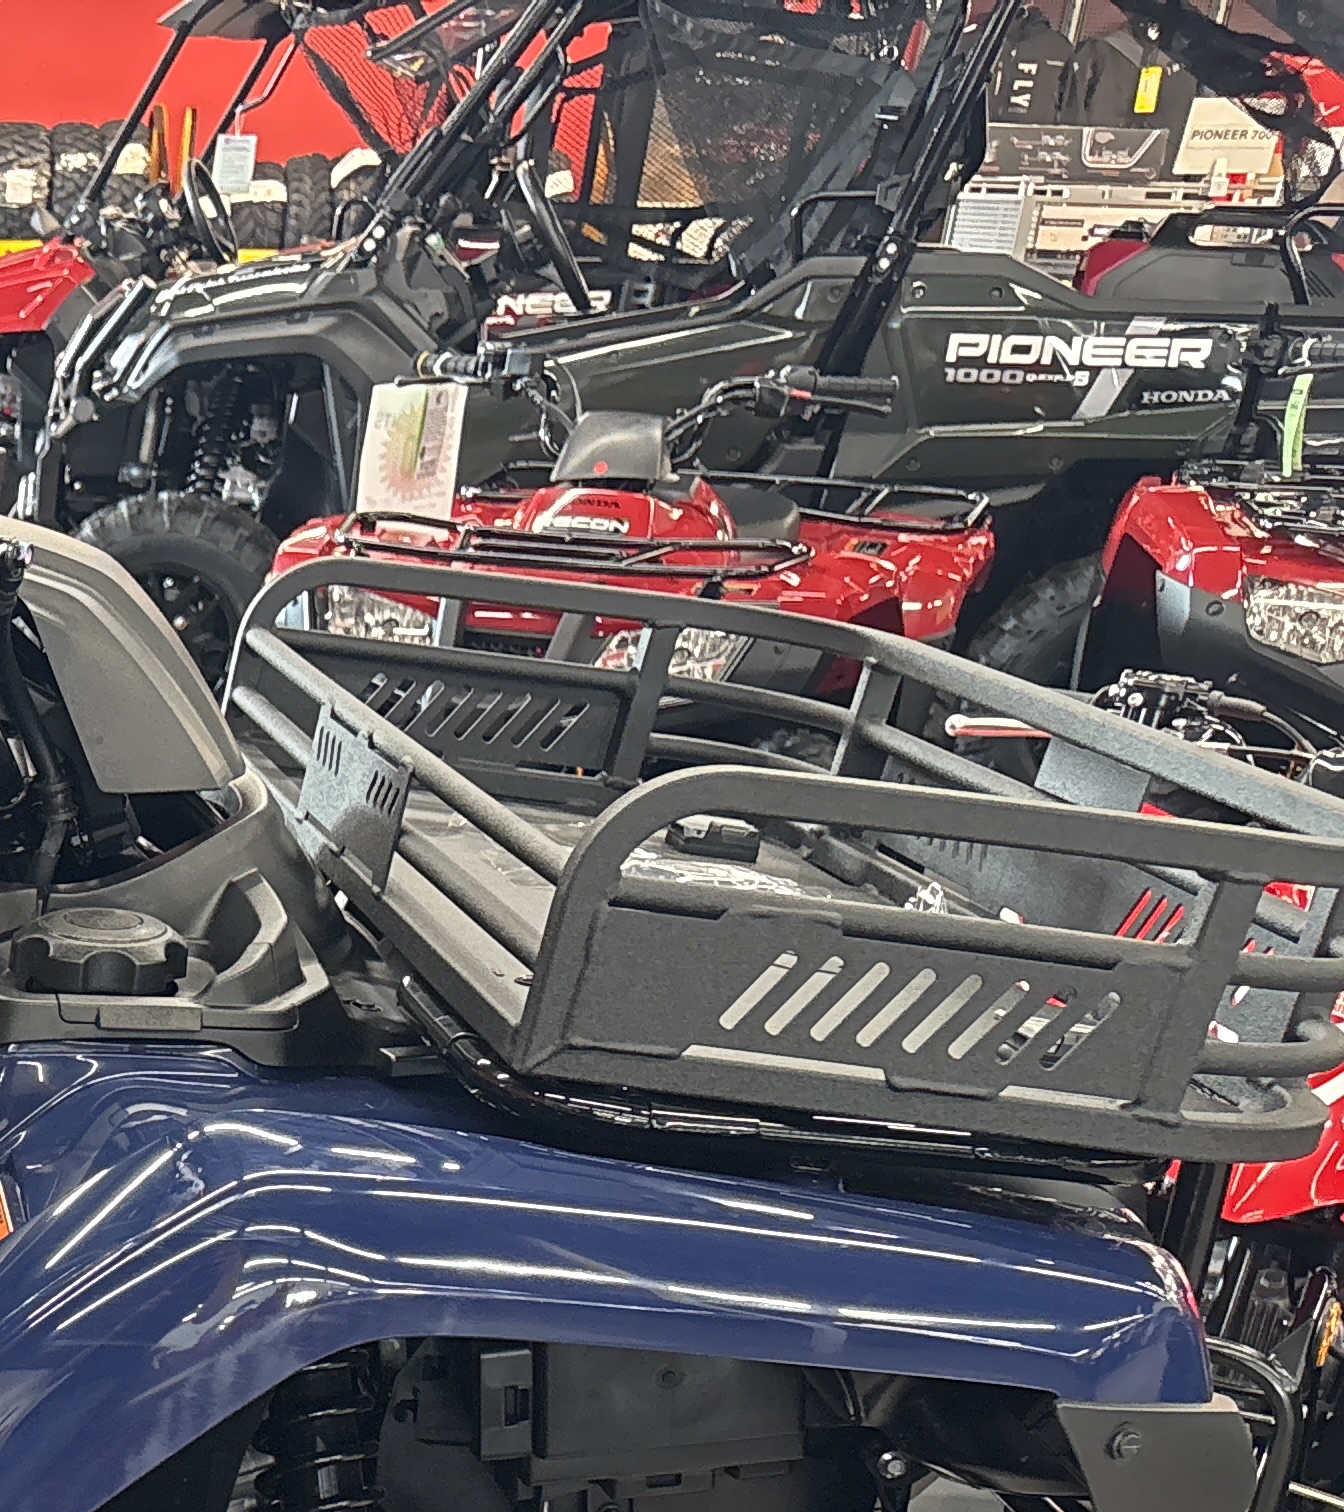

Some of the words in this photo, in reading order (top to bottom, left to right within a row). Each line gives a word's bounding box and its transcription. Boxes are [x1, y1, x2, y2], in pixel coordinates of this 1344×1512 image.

[1009, 62, 1038, 107] FLY
[1191, 129, 1246, 141] PIONEER
[944, 332, 1213, 369] PIONEER
[944, 367, 1024, 385] 1000
[1141, 389, 1232, 405] HONDA
